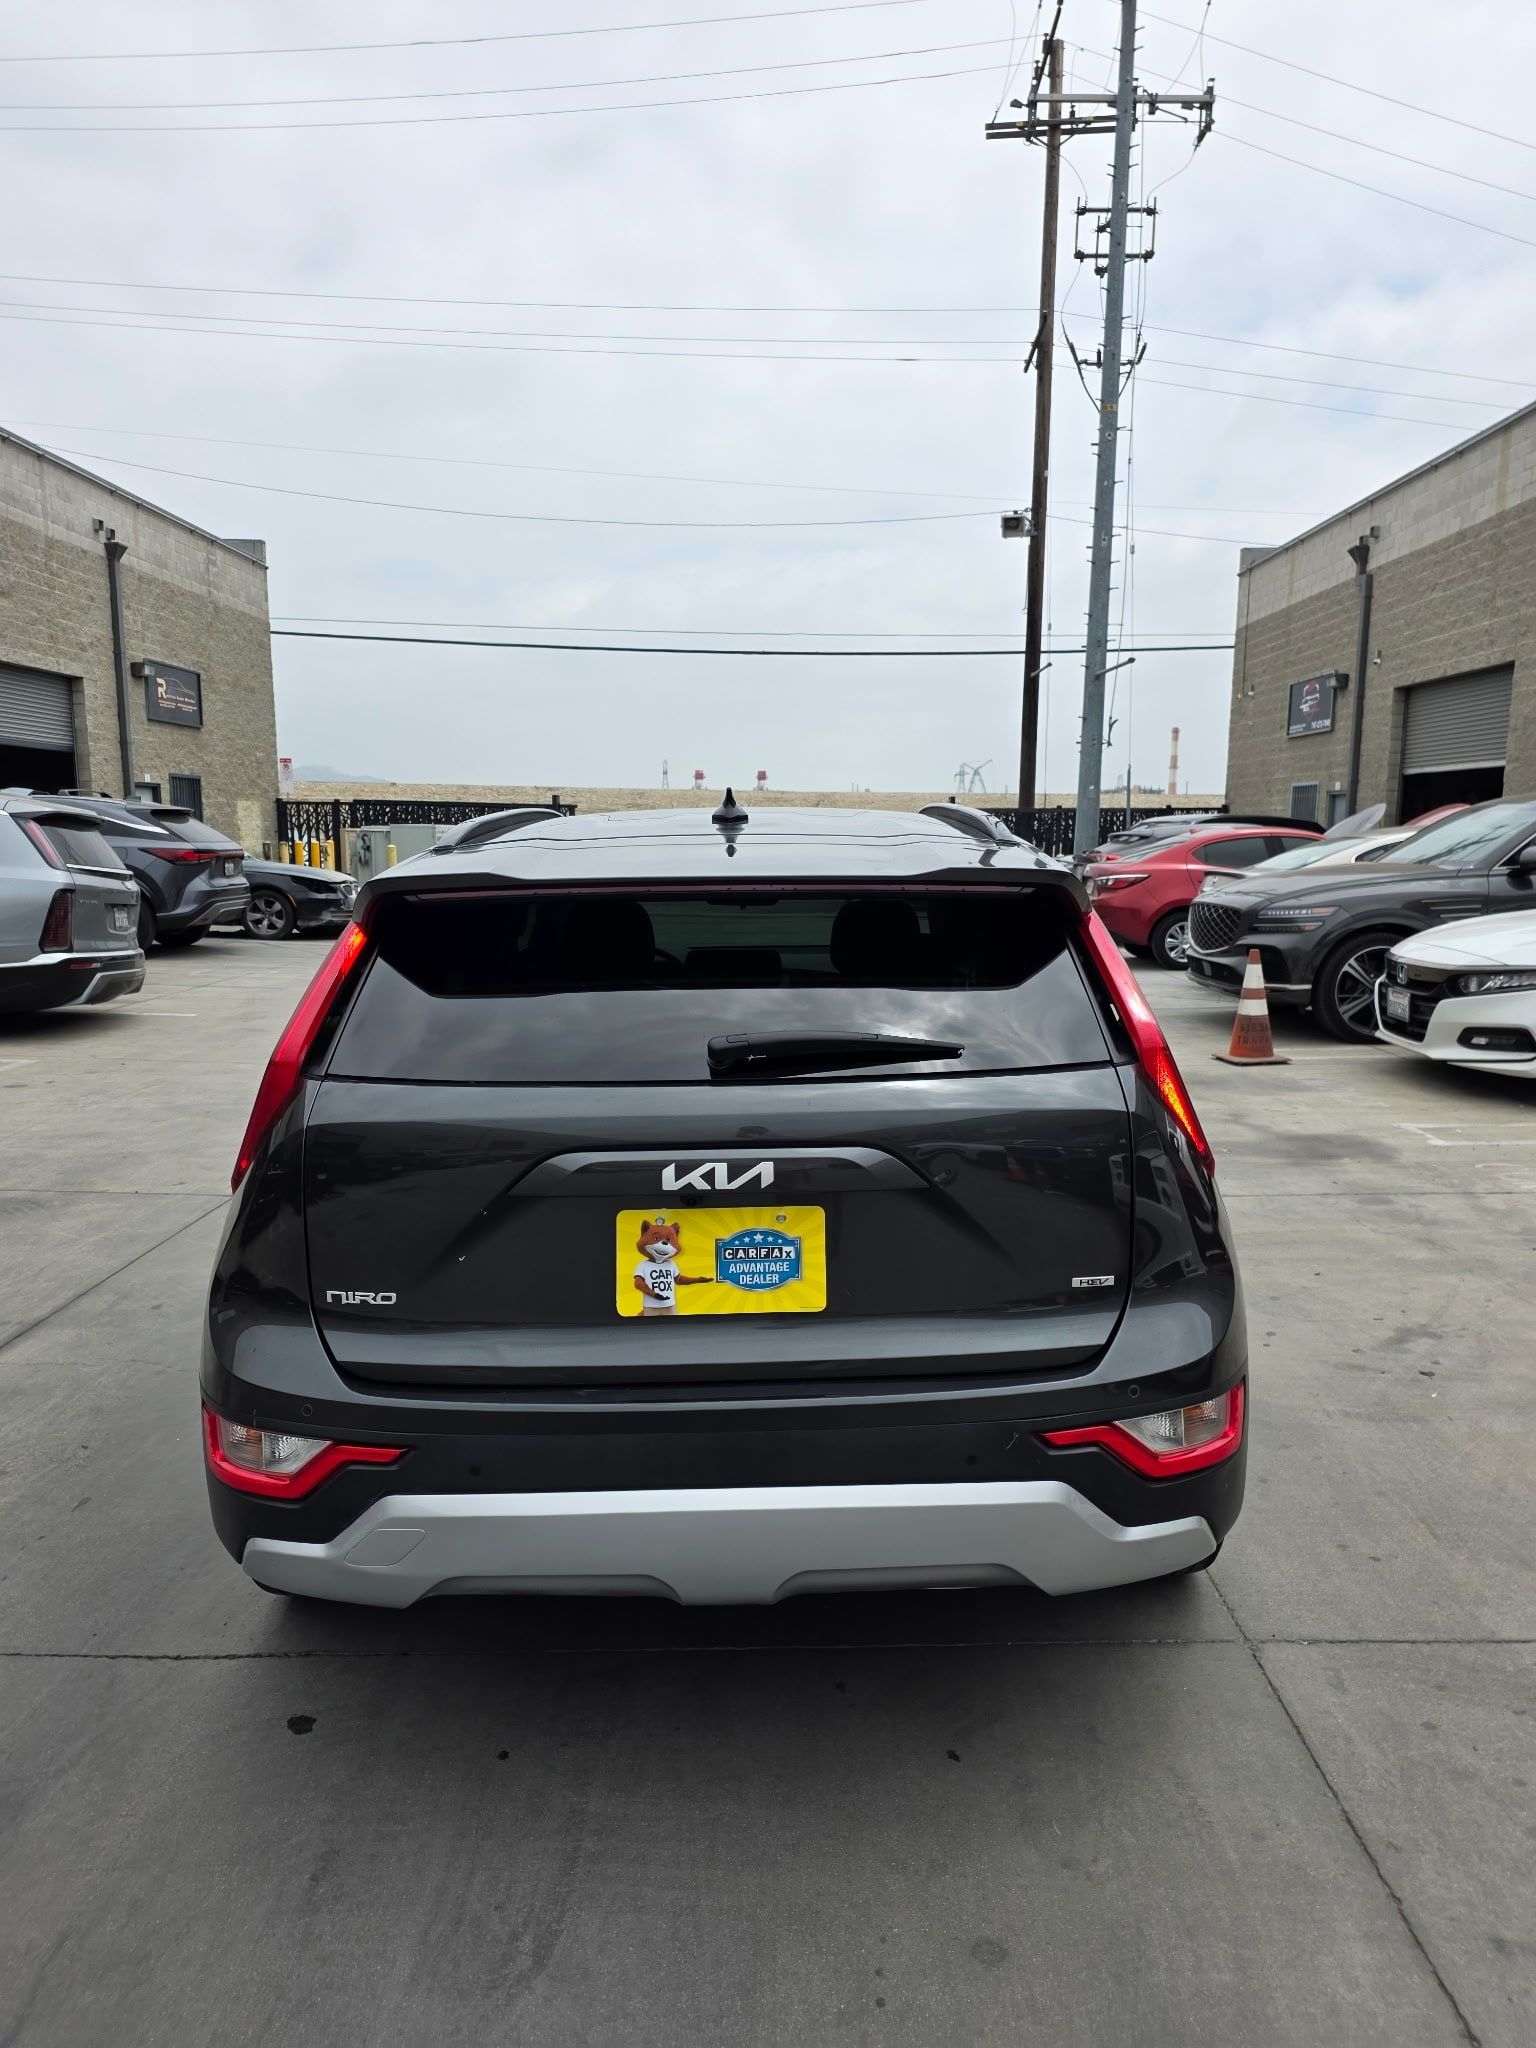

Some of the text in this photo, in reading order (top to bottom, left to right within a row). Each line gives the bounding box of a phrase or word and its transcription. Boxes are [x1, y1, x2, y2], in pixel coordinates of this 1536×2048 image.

[662, 1161, 775, 1190] KIA
[723, 1247, 794, 1260] CARFAX
[728, 1261, 790, 1273] ADVANTAGE
[649, 1269, 673, 1280] CAR
[739, 1273, 780, 1285] DEALER
[651, 1280, 673, 1293] FOX
[326, 1290, 397, 1305] NIRO
